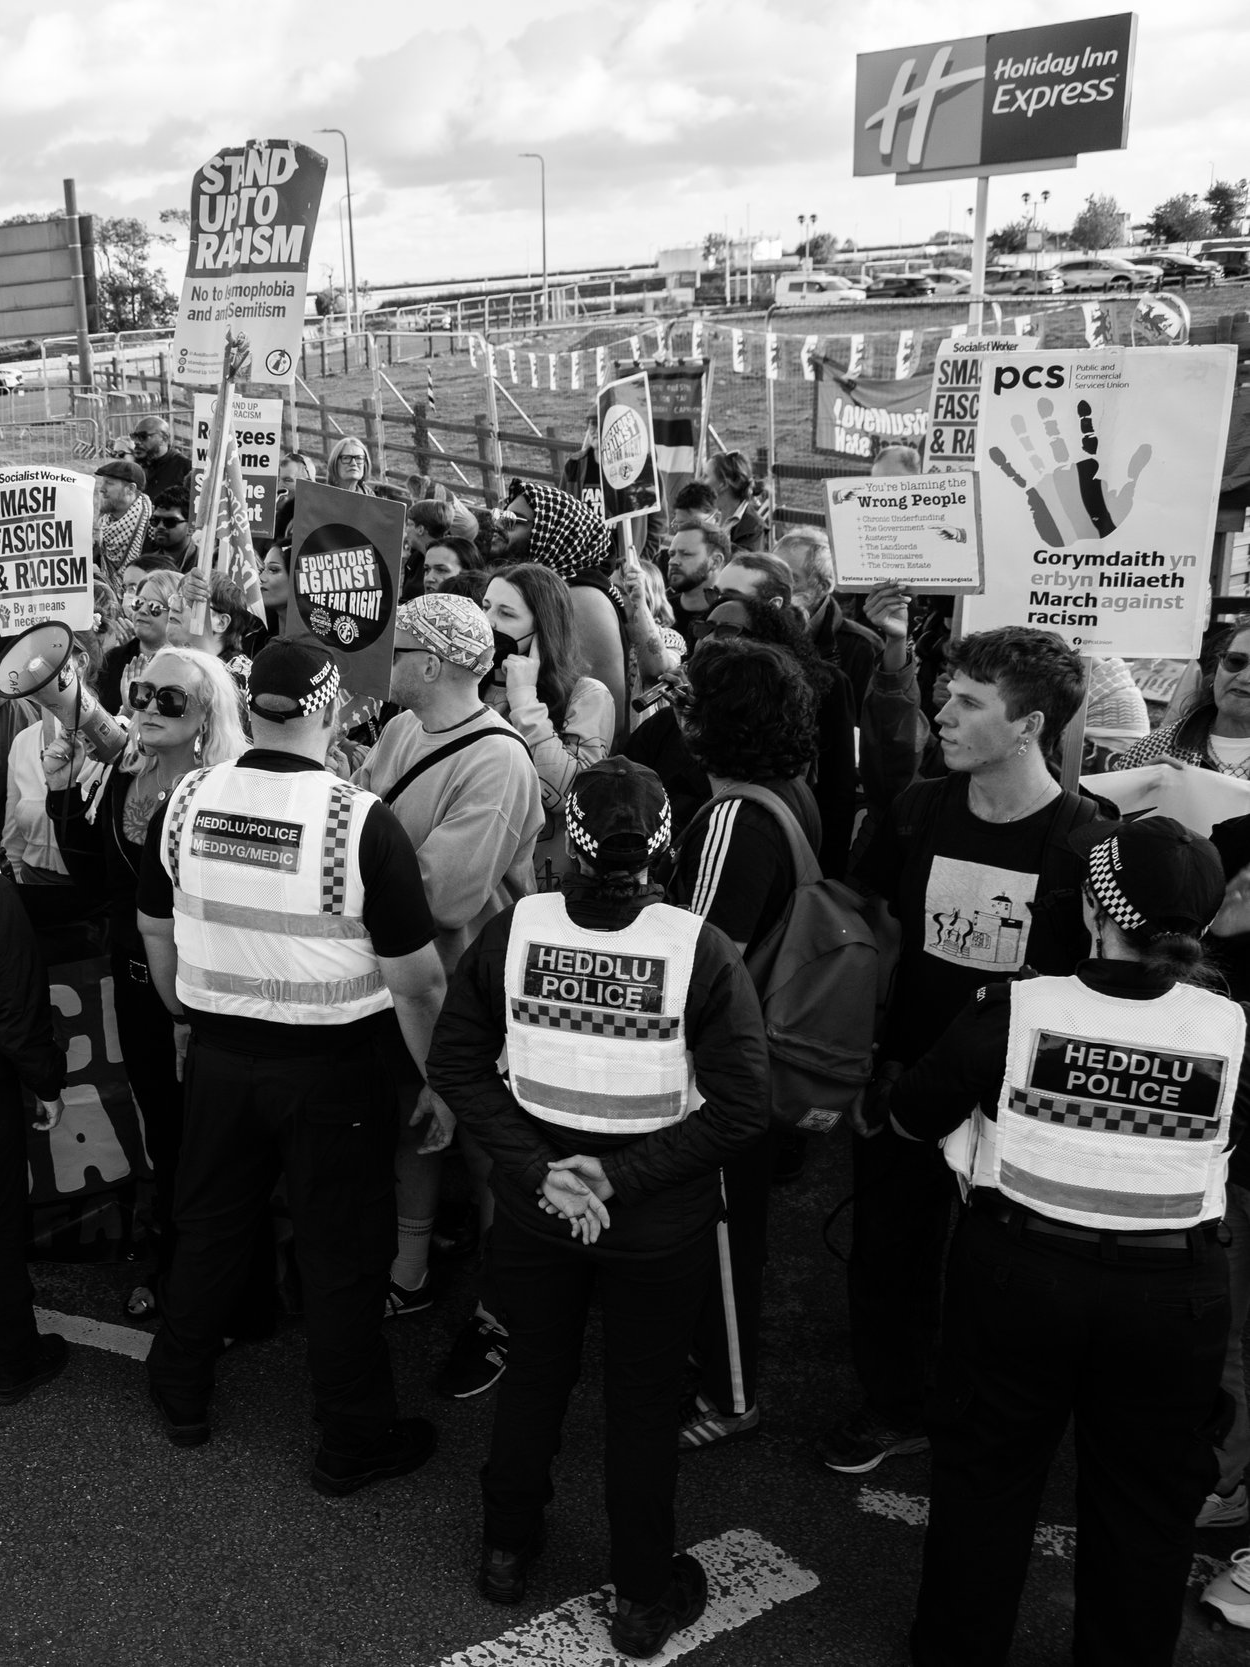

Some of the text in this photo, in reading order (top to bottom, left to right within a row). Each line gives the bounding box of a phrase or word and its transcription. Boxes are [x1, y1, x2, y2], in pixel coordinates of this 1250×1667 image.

[993, 46, 1118, 81] Holiday Inn
[992, 77, 1117, 118] Express
[200, 186, 278, 232] UP TO
[191, 286, 223, 302] No to
[187, 308, 211, 322] and
[953, 341, 1019, 352] Socialist Worker
[1075, 372, 1121, 380] Commercial
[1076, 364, 1115, 372] Public and
[994, 365, 1065, 395] pcs
[1074, 381, 1129, 390] Services Union
[234, 410, 261, 420] RACISM
[248, 402, 258, 411] UP
[930, 429, 944, 454] &
[0, 471, 77, 484] Socialist Worker
[865, 478, 967, 492] You're blaming the
[857, 493, 966, 510] Wrong People
[862, 514, 946, 523] Chronic Underfunding
[864, 534, 898, 543] Austerity
[880, 543, 917, 551] Landlords
[301, 549, 373, 572] EDUCATORS
[881, 552, 923, 560] Billionaires
[1033, 549, 1197, 571] Gorymdaith yn
[15, 556, 87, 590] RACISM
[299, 564, 375, 594] AGAINST
[1030, 571, 1185, 590] erbyn hiliaeth
[13, 602, 25, 615] By
[309, 590, 383, 621] THE FAR RIGHT
[1029, 591, 1184, 613] March against
[1028, 610, 1098, 626] racism
[310, 661, 332, 687] HEDDLU
[195, 815, 298, 842] HEDDLU/POLICE
[193, 838, 294, 865] MEDDYG/MEDIC
[538, 947, 651, 982] HEDDLU
[542, 976, 643, 1009] POLICE
[1064, 1044, 1194, 1082] HEDDLU
[1066, 1071, 1182, 1107] POLICE
